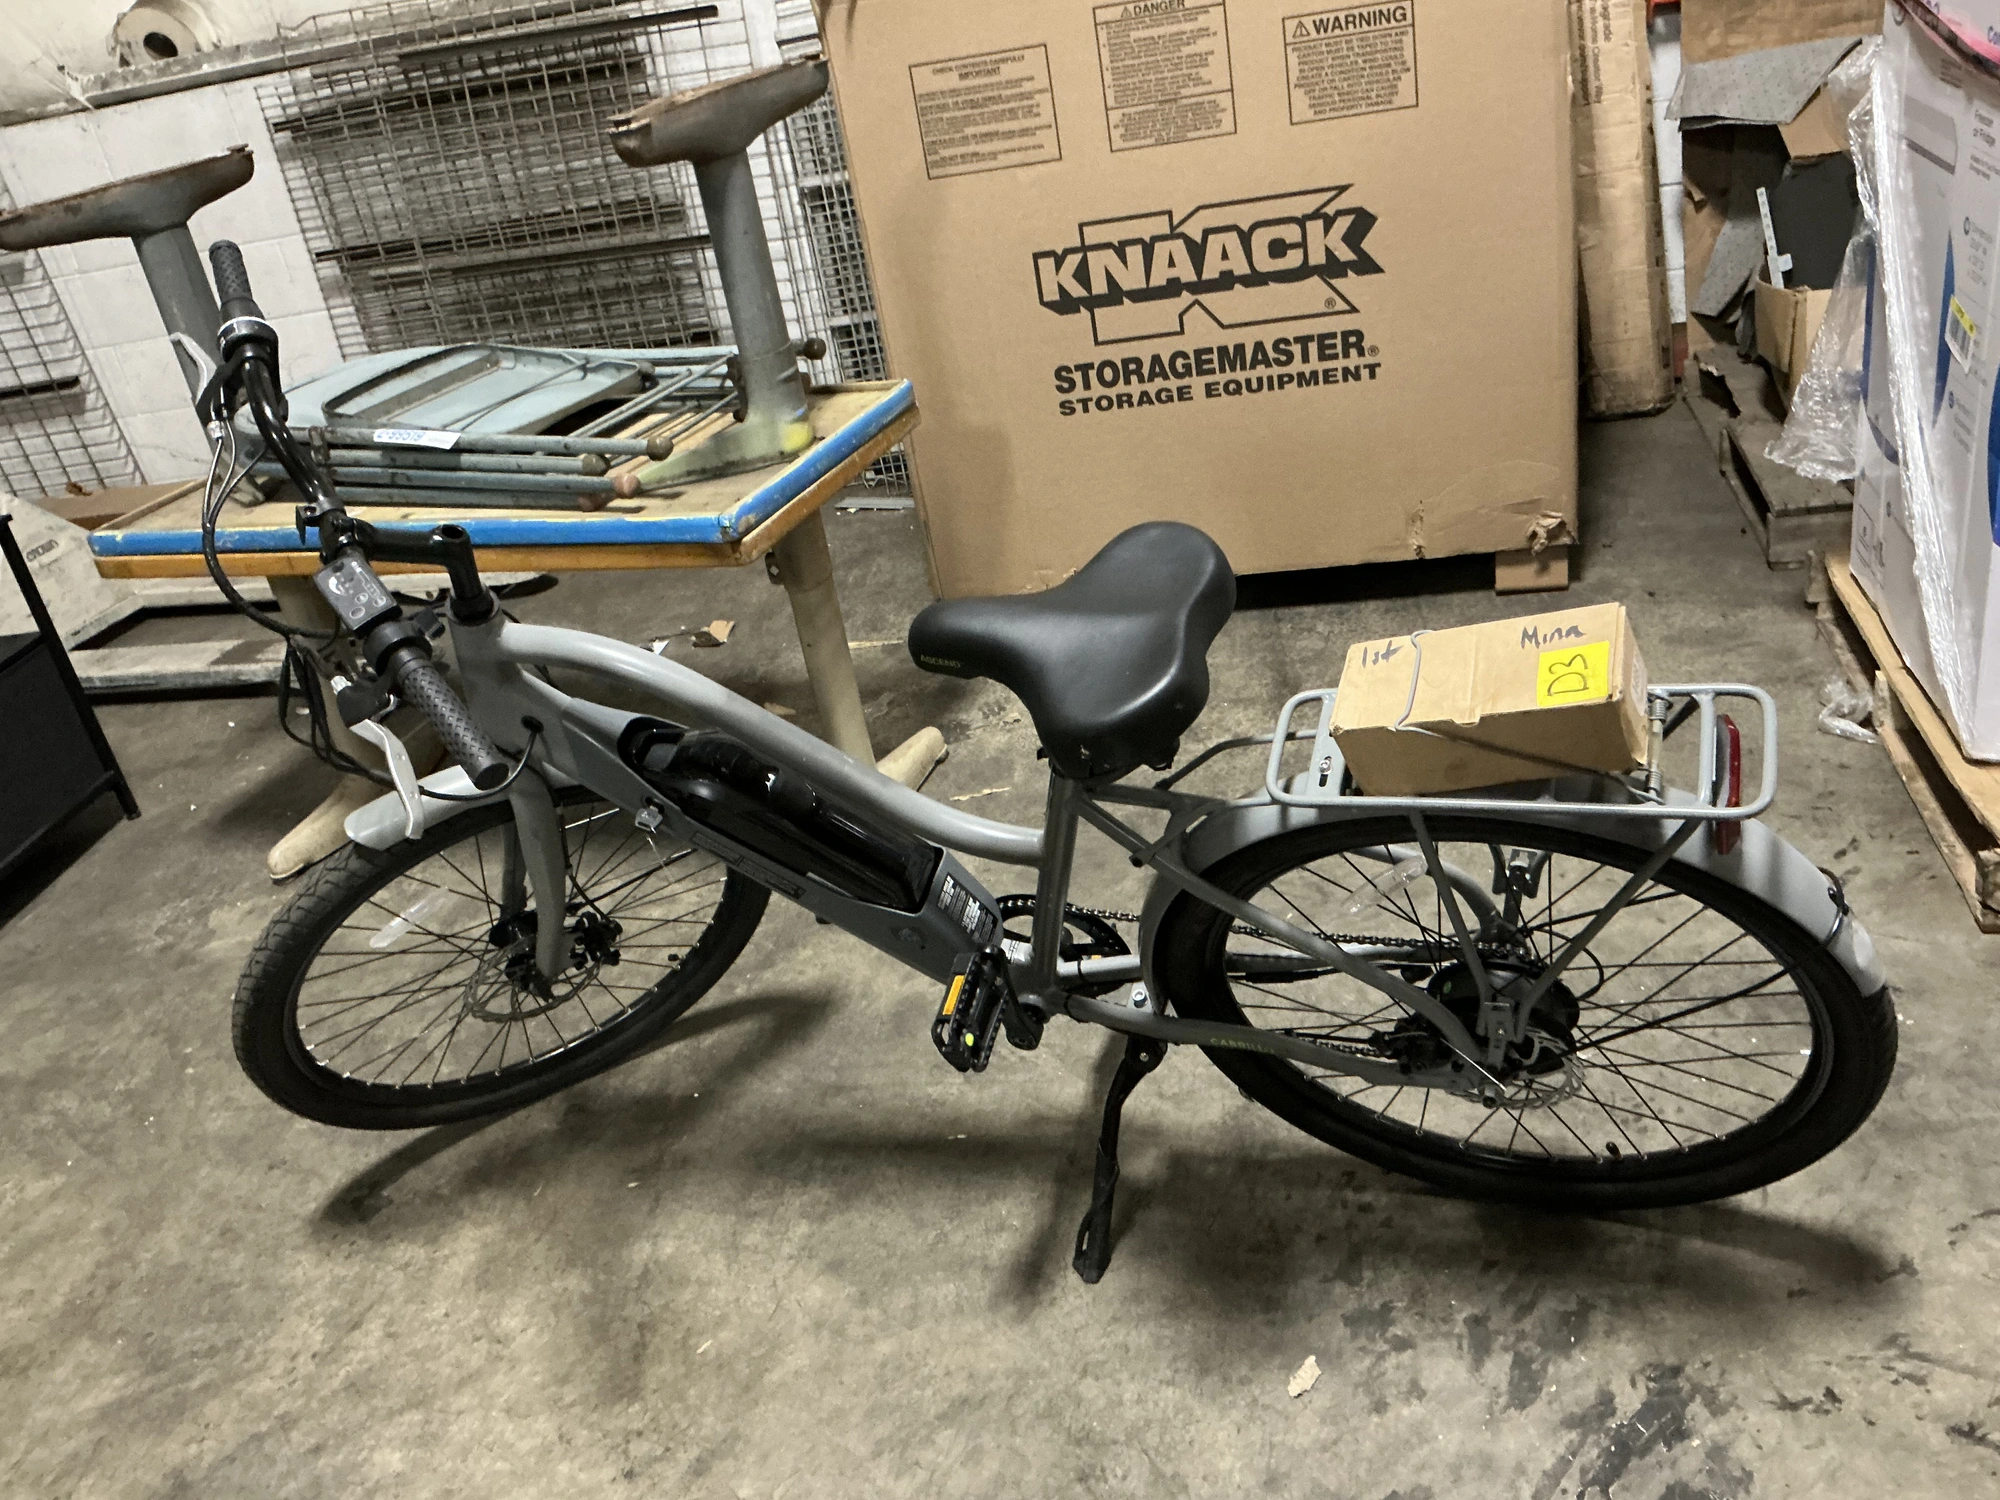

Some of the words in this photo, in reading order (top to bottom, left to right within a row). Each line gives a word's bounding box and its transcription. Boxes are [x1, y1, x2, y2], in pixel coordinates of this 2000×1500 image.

[1133, 0, 1185, 15] DANGER
[1312, 5, 1407, 35] WARNING
[957, 66, 1001, 81] IMPORTANT
[1032, 206, 1385, 315] KNAACK
[1059, 384, 1193, 416] STORAGE
[1204, 363, 1382, 399] EQUIPMENT
[1361, 640, 1404, 668] 1st
[1546, 653, 1588, 697] D3
